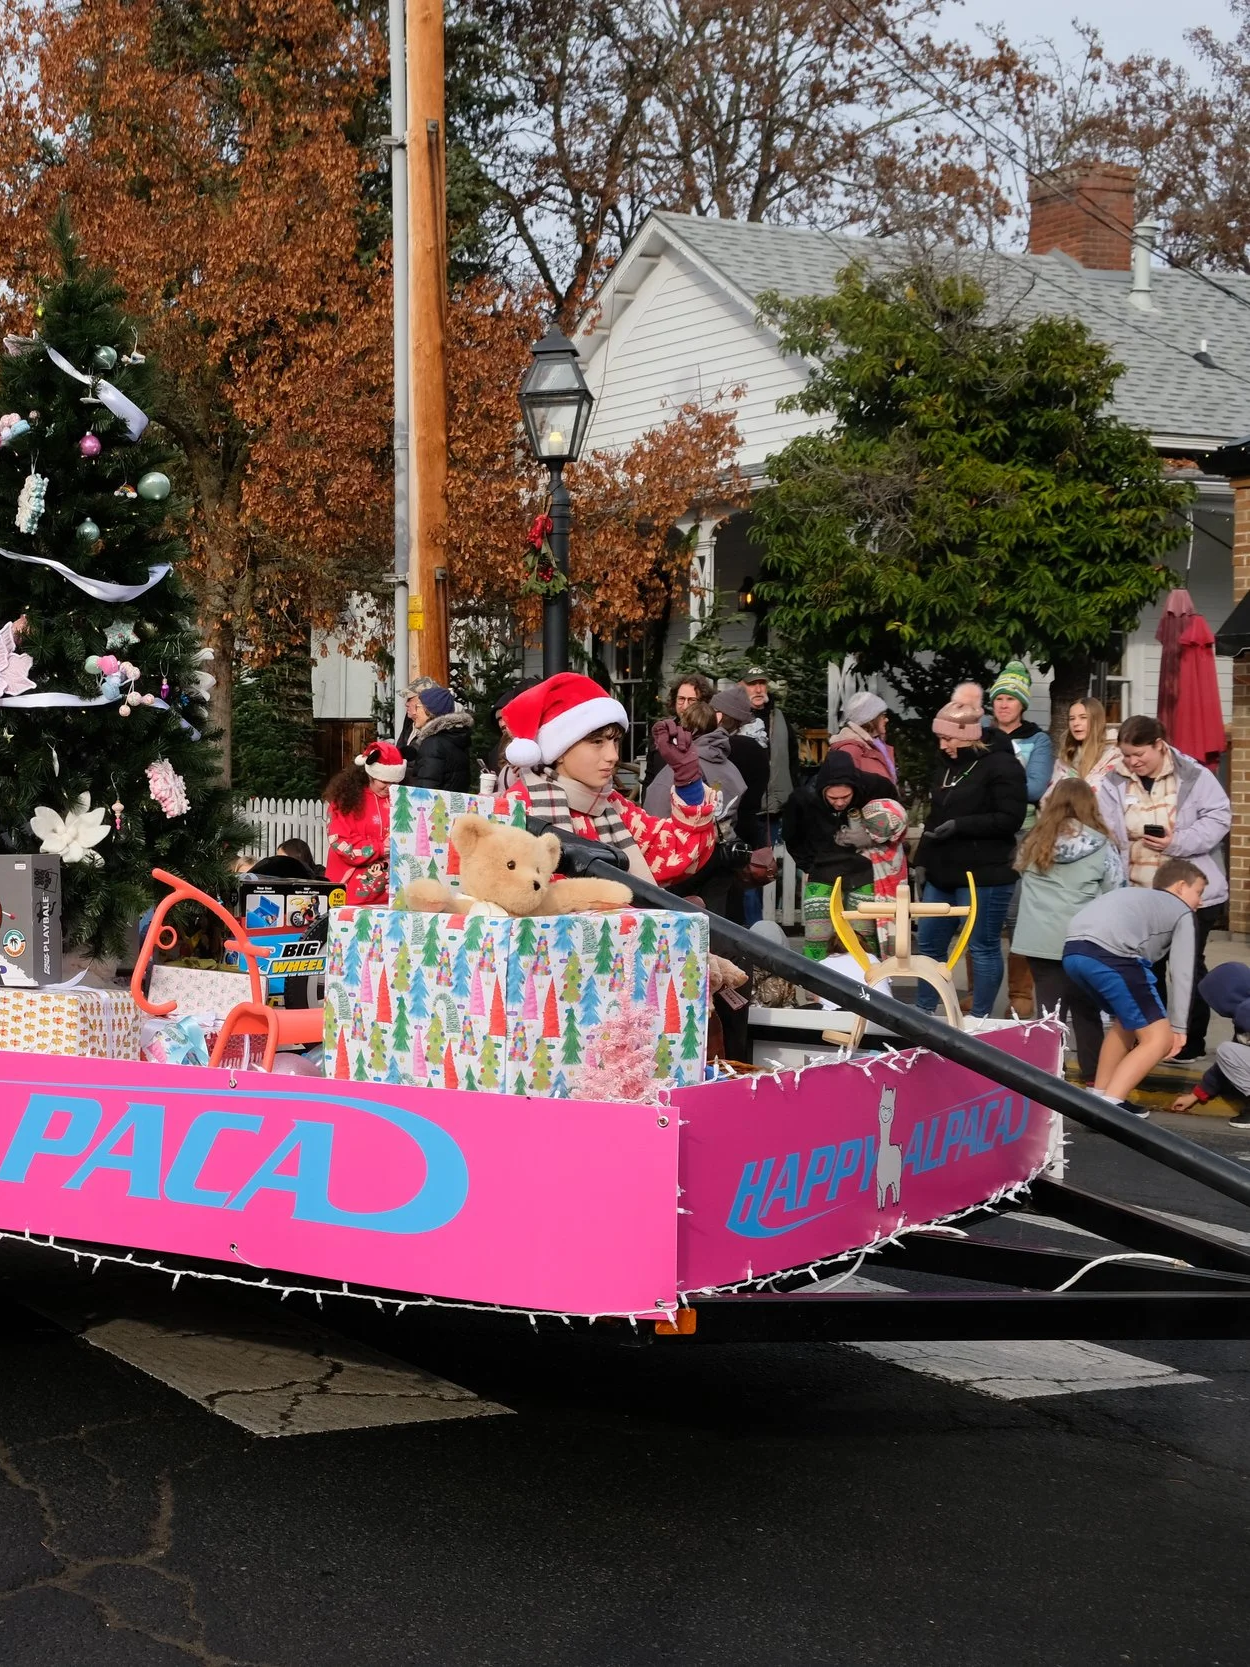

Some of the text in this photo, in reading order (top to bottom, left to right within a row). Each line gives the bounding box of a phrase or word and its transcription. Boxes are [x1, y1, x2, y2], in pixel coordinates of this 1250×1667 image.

[282, 942, 319, 958] BIG
[272, 958, 324, 973] WHEEL
[726, 1092, 1020, 1238] HAPPY ALPACA
